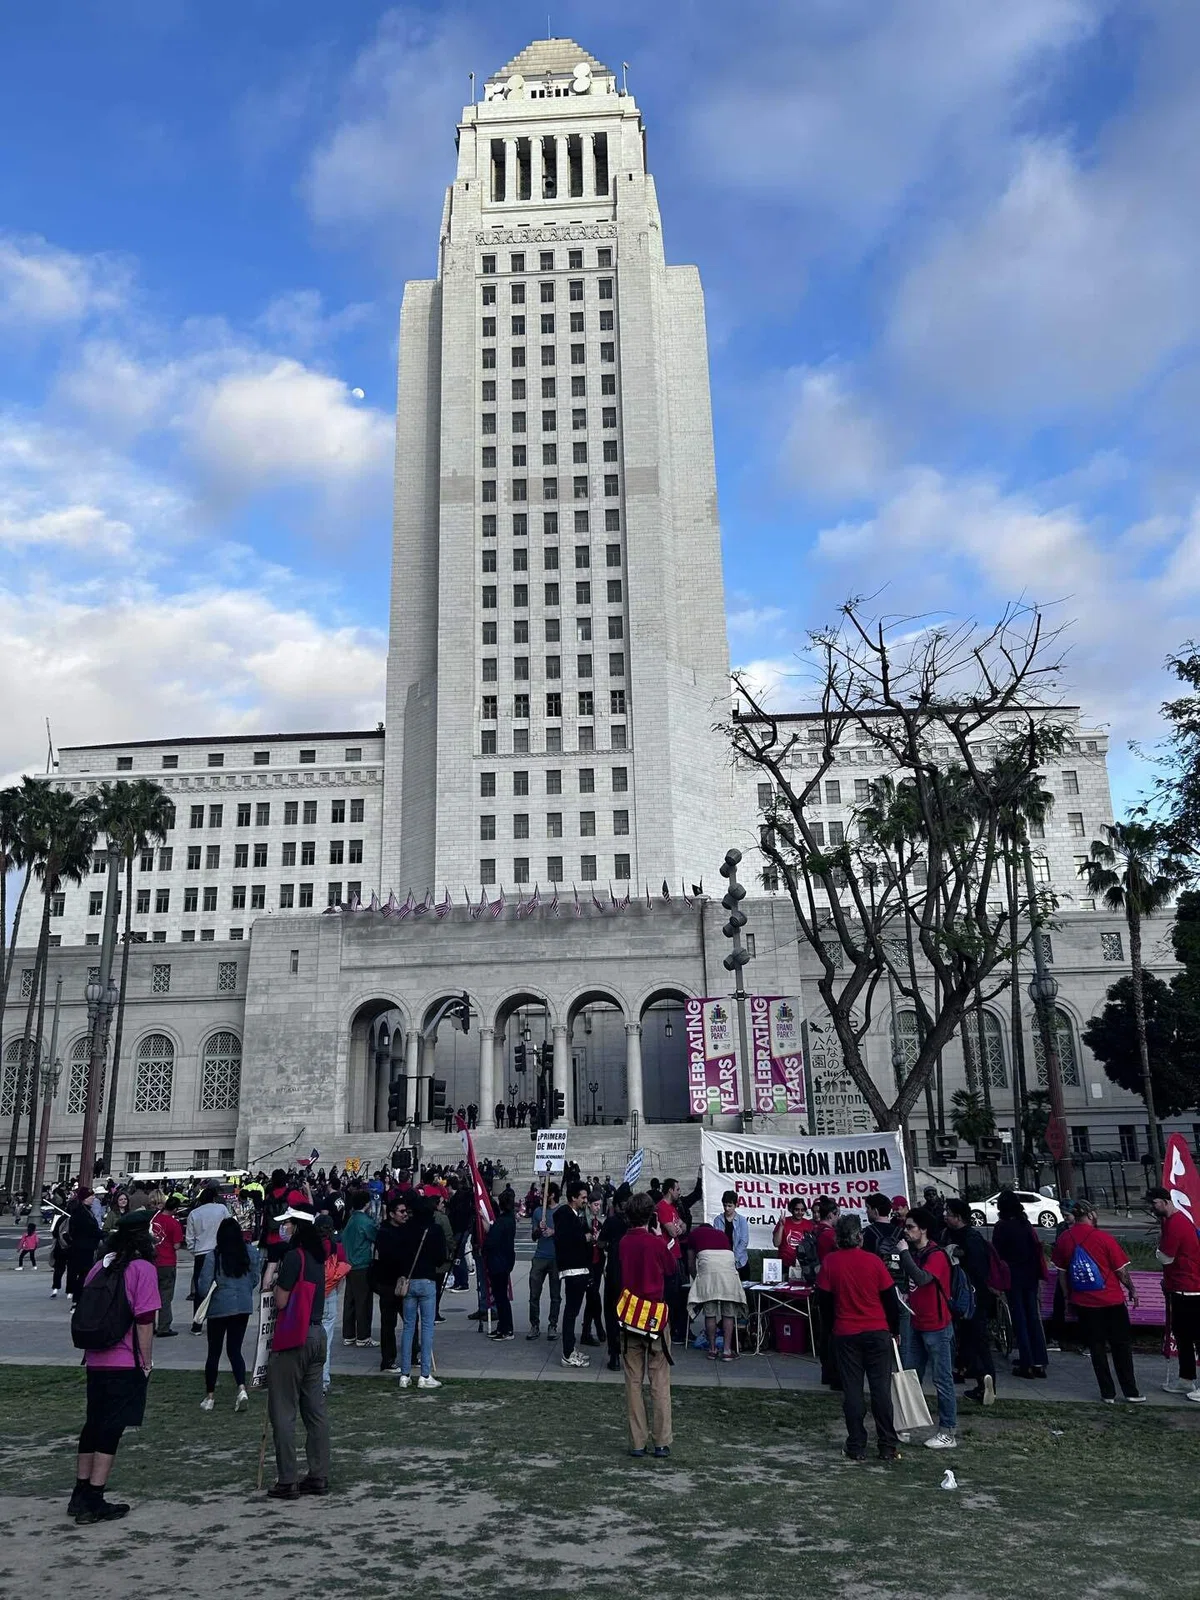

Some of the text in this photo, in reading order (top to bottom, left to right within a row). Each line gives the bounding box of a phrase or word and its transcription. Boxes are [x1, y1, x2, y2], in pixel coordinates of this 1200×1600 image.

[686, 1000, 707, 1113] CELEBRATING
[752, 998, 774, 1112] CELEBRATING
[706, 1086, 721, 1104] 10
[718, 1058, 740, 1113] YEARS
[772, 1084, 787, 1103] 10
[784, 1057, 806, 1112] YEARS
[717, 1147, 892, 1176] LEGALIZACIÓN AHORA
[734, 1180, 880, 1195] FULL RIGHTS FOR
[737, 1195, 765, 1208] ALL
